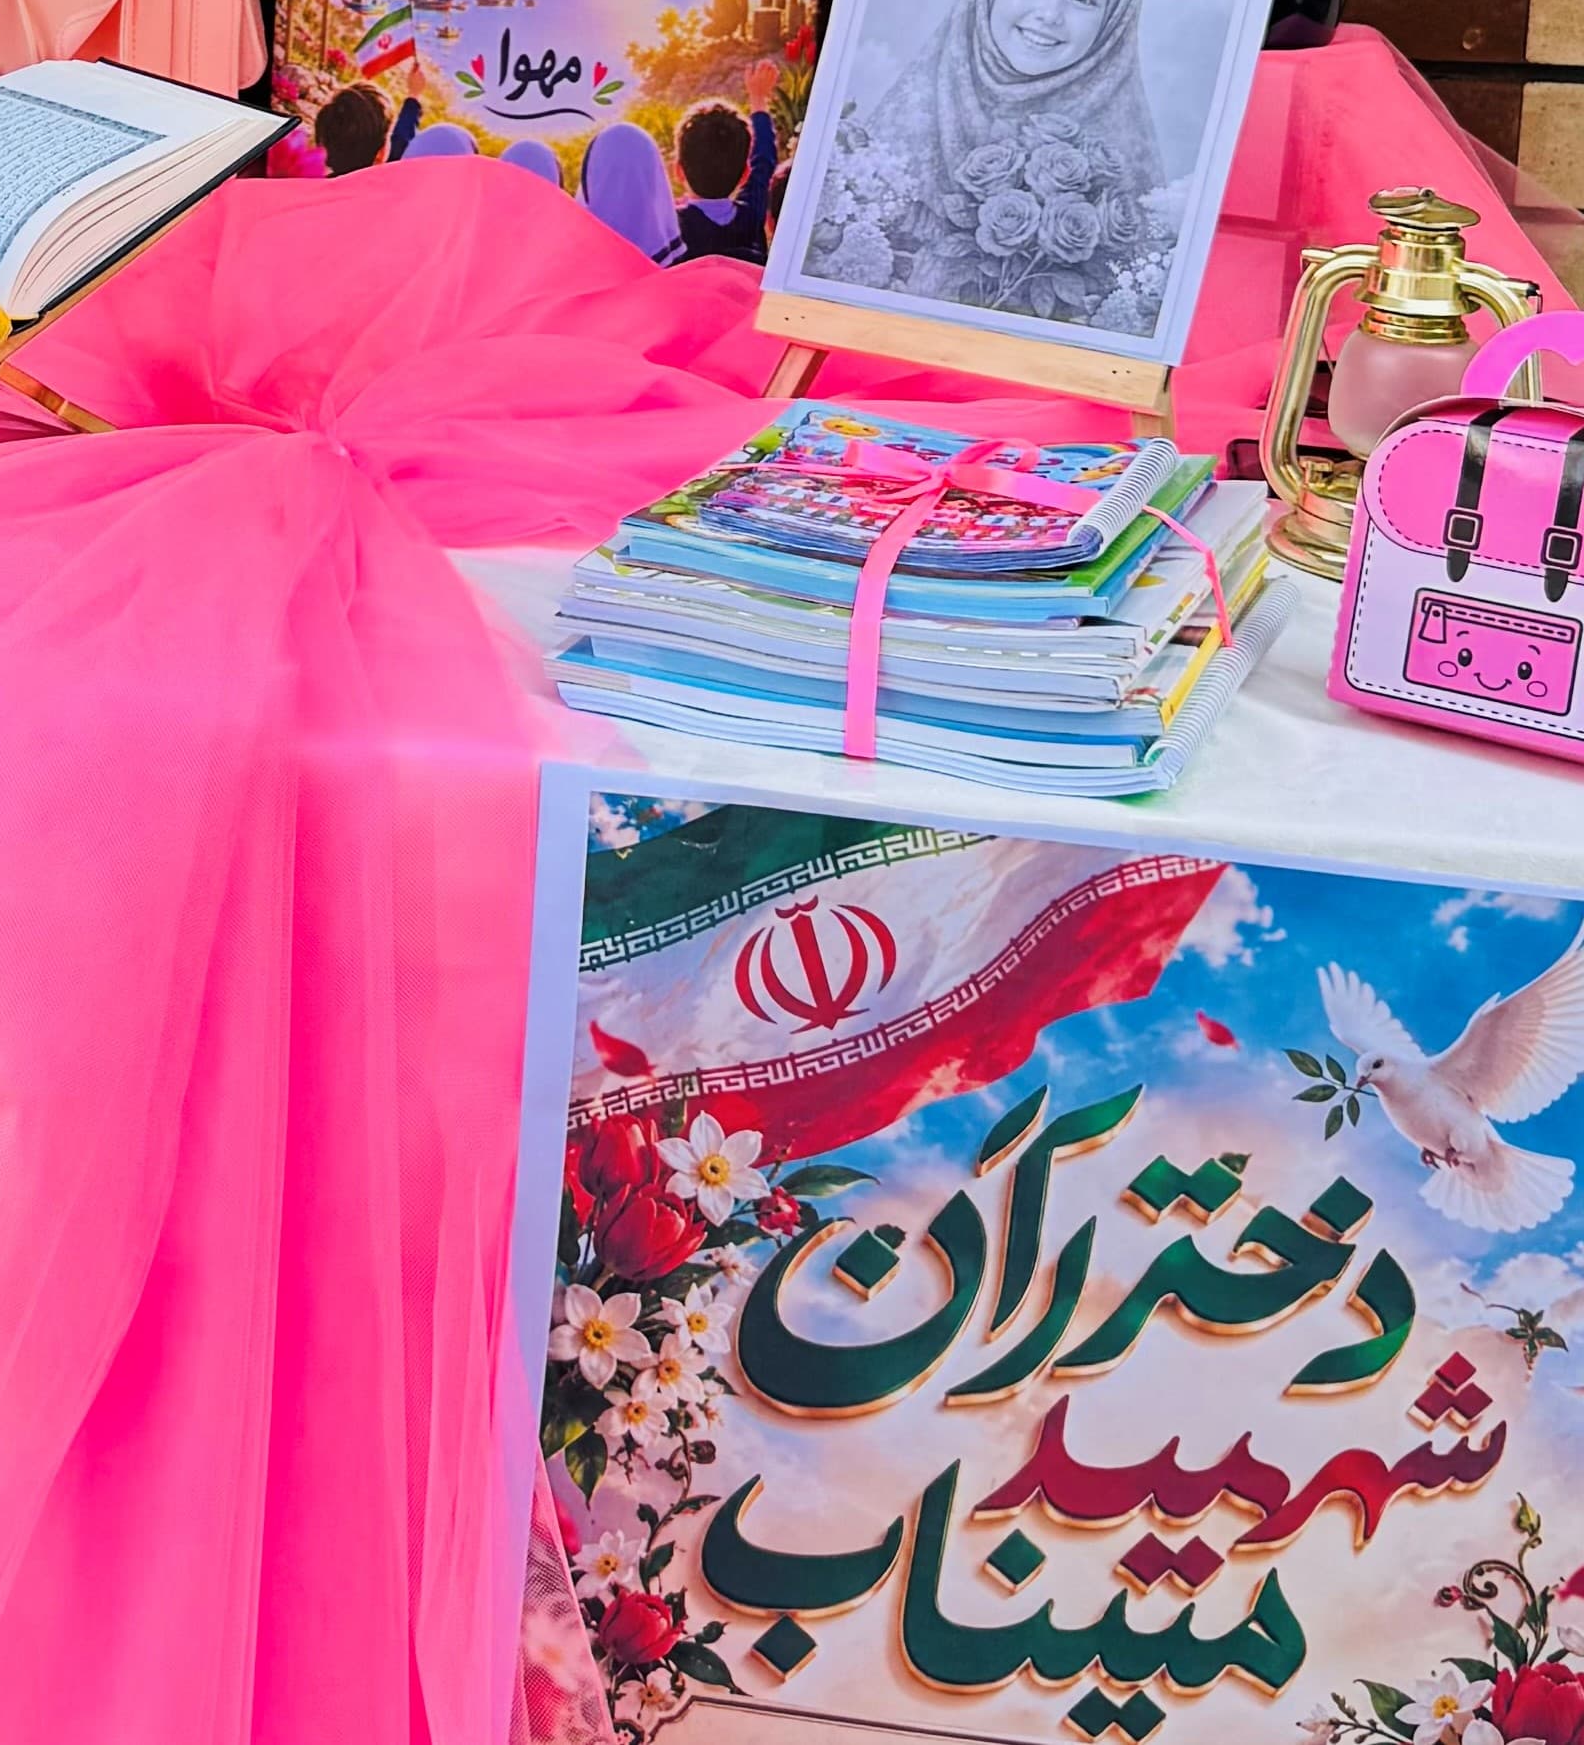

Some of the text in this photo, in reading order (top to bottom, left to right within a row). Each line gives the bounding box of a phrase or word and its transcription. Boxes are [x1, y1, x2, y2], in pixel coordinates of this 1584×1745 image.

[498, 27, 582, 101] مهوا
[735, 1083, 1417, 1420] دختران
[700, 1458, 1309, 1744] میناب
[972, 1351, 1509, 1595] شهید
